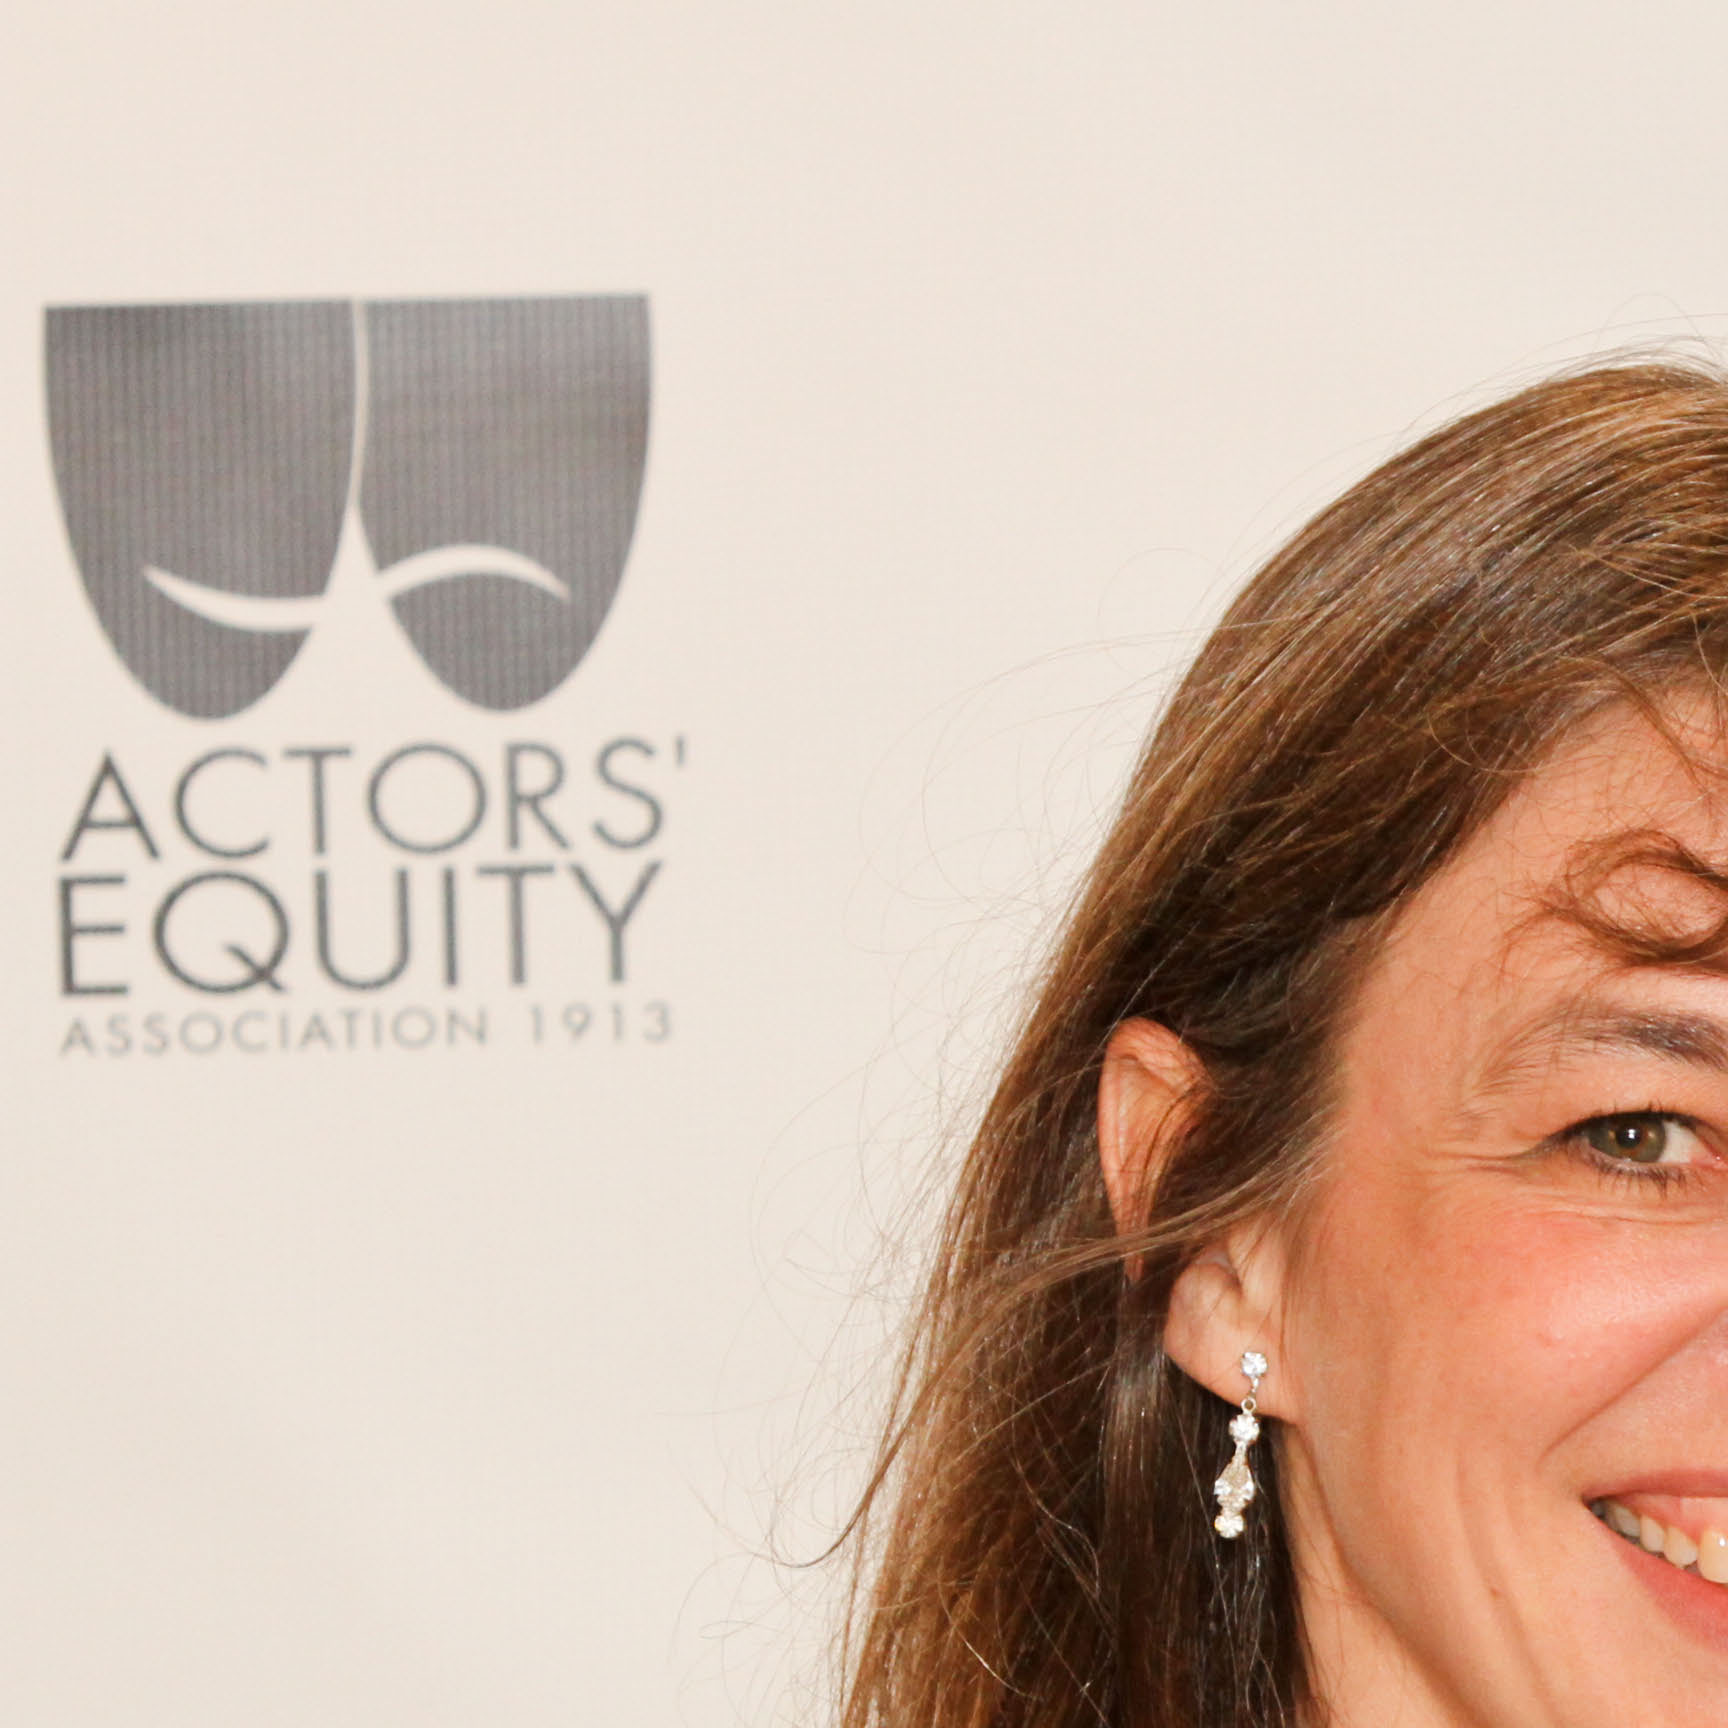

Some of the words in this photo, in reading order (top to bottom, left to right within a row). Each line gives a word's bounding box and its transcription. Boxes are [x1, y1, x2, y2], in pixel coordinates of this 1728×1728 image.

[60, 736, 686, 863] ACTORS'
[58, 859, 664, 998] EQUITY
[59, 1006, 489, 1059] ASSOCIATION
[530, 1001, 674, 1046] 1913
